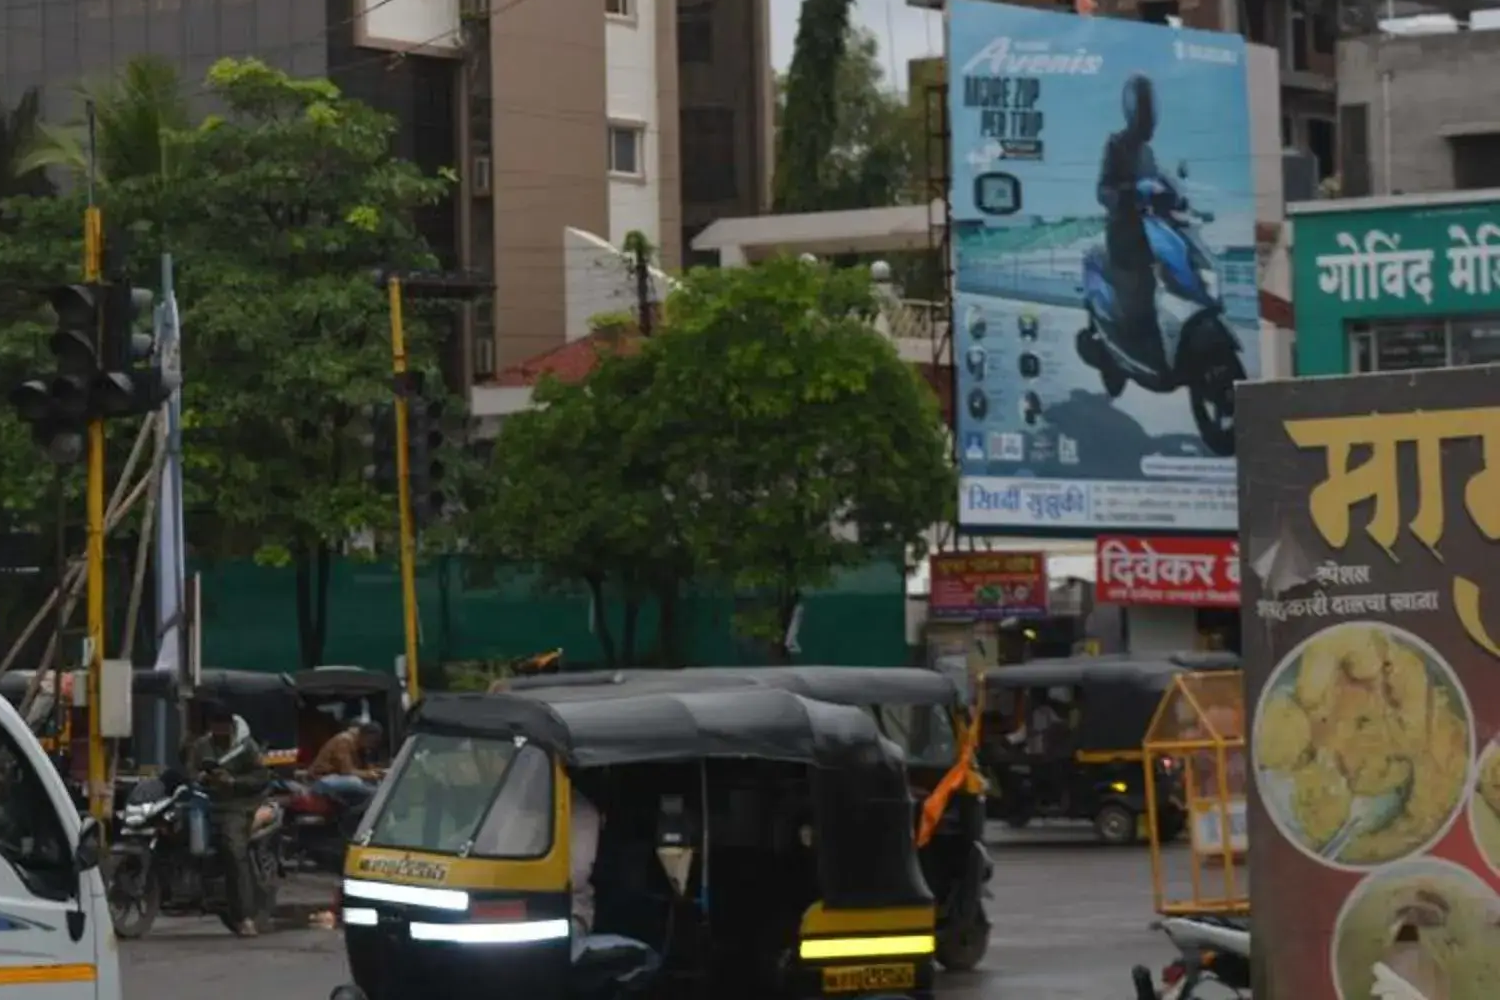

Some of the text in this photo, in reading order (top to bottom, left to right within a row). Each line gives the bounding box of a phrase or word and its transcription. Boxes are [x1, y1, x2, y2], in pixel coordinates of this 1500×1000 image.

[961, 37, 1104, 75] Avenis
[1315, 228, 1435, 305] गोविंद
[1101, 538, 1218, 588] दिवेकर
